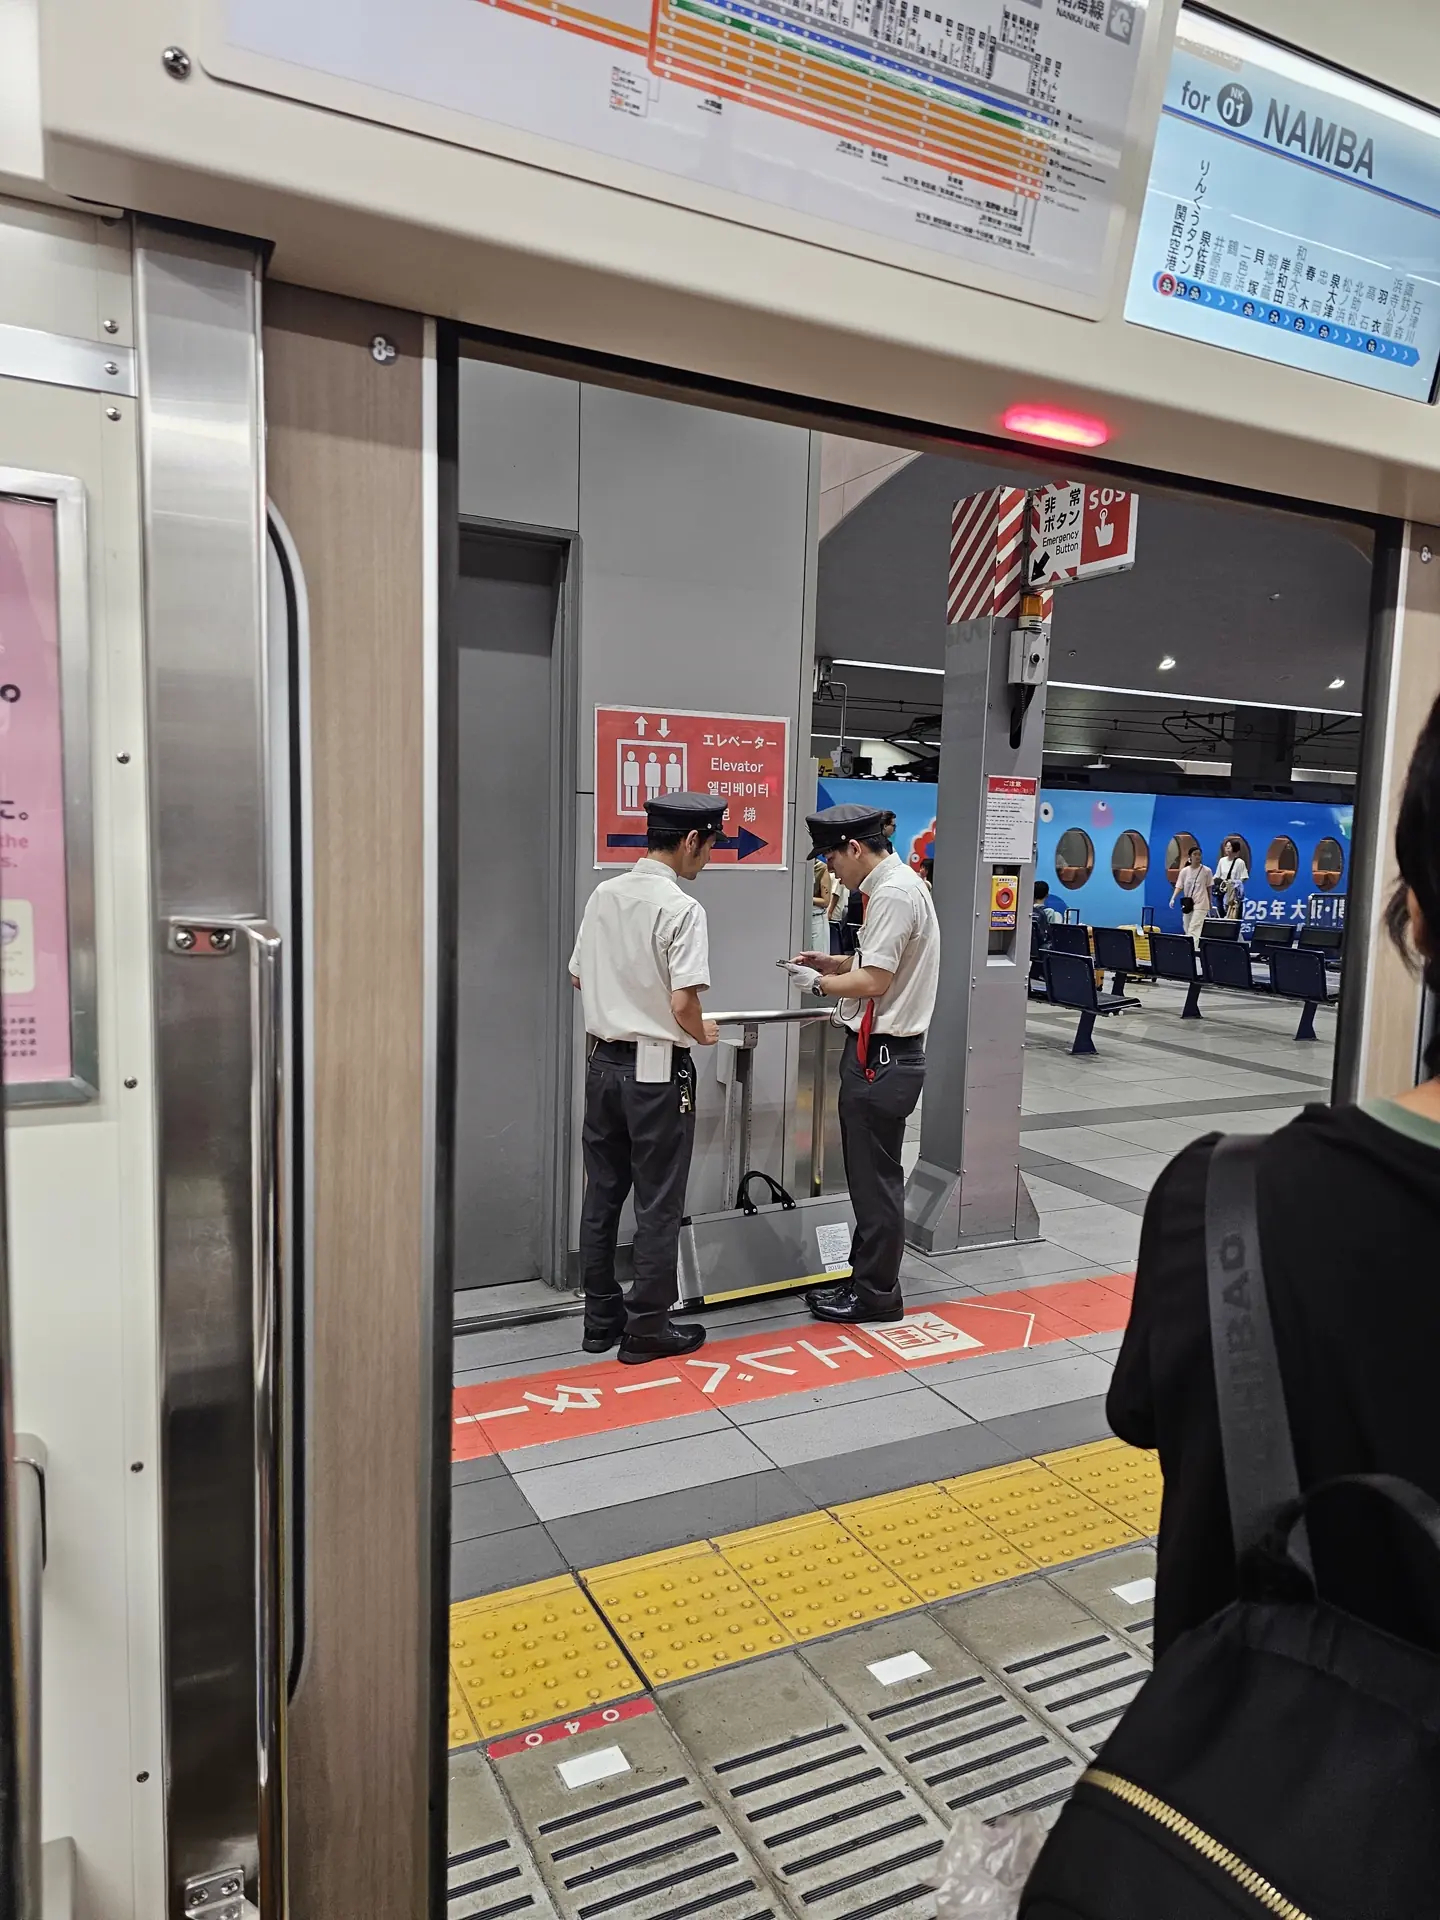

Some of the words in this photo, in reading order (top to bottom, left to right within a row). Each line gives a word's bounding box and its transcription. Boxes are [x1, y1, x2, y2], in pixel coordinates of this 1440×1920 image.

[1056, 7, 1082, 26] NANKAI
[1084, 18, 1100, 33] LINE
[1222, 98, 1245, 124] 01
[1230, 86, 1245, 99] NK
[1180, 80, 1211, 113] for
[1263, 98, 1374, 179] NAMBA
[1180, 159, 1211, 274] りんくうタウン
[1193, 230, 1212, 280] 泉佐野
[1286, 245, 1308, 308] 和泉大宮
[1273, 256, 1291, 304] 岸和田
[1298, 265, 1317, 311] 春木
[1323, 273, 1341, 319] 泉大津
[1335, 276, 1353, 323] 松ノ浜
[1359, 285, 1377, 331] 高石
[1371, 288, 1389, 334] 羽衣
[1404, 300, 1423, 344] 石津川
[1043, 509, 1080, 532] ボタン
[1044, 487, 1081, 514] 非常
[1042, 530, 1080, 548] Emergency
[1055, 542, 1079, 555] Button
[702, 733, 777, 750] エレベーター
[710, 757, 764, 773] Elevator
[707, 780, 769, 798] 엘리베이터
[454, 1335, 873, 1425] エレベーター
